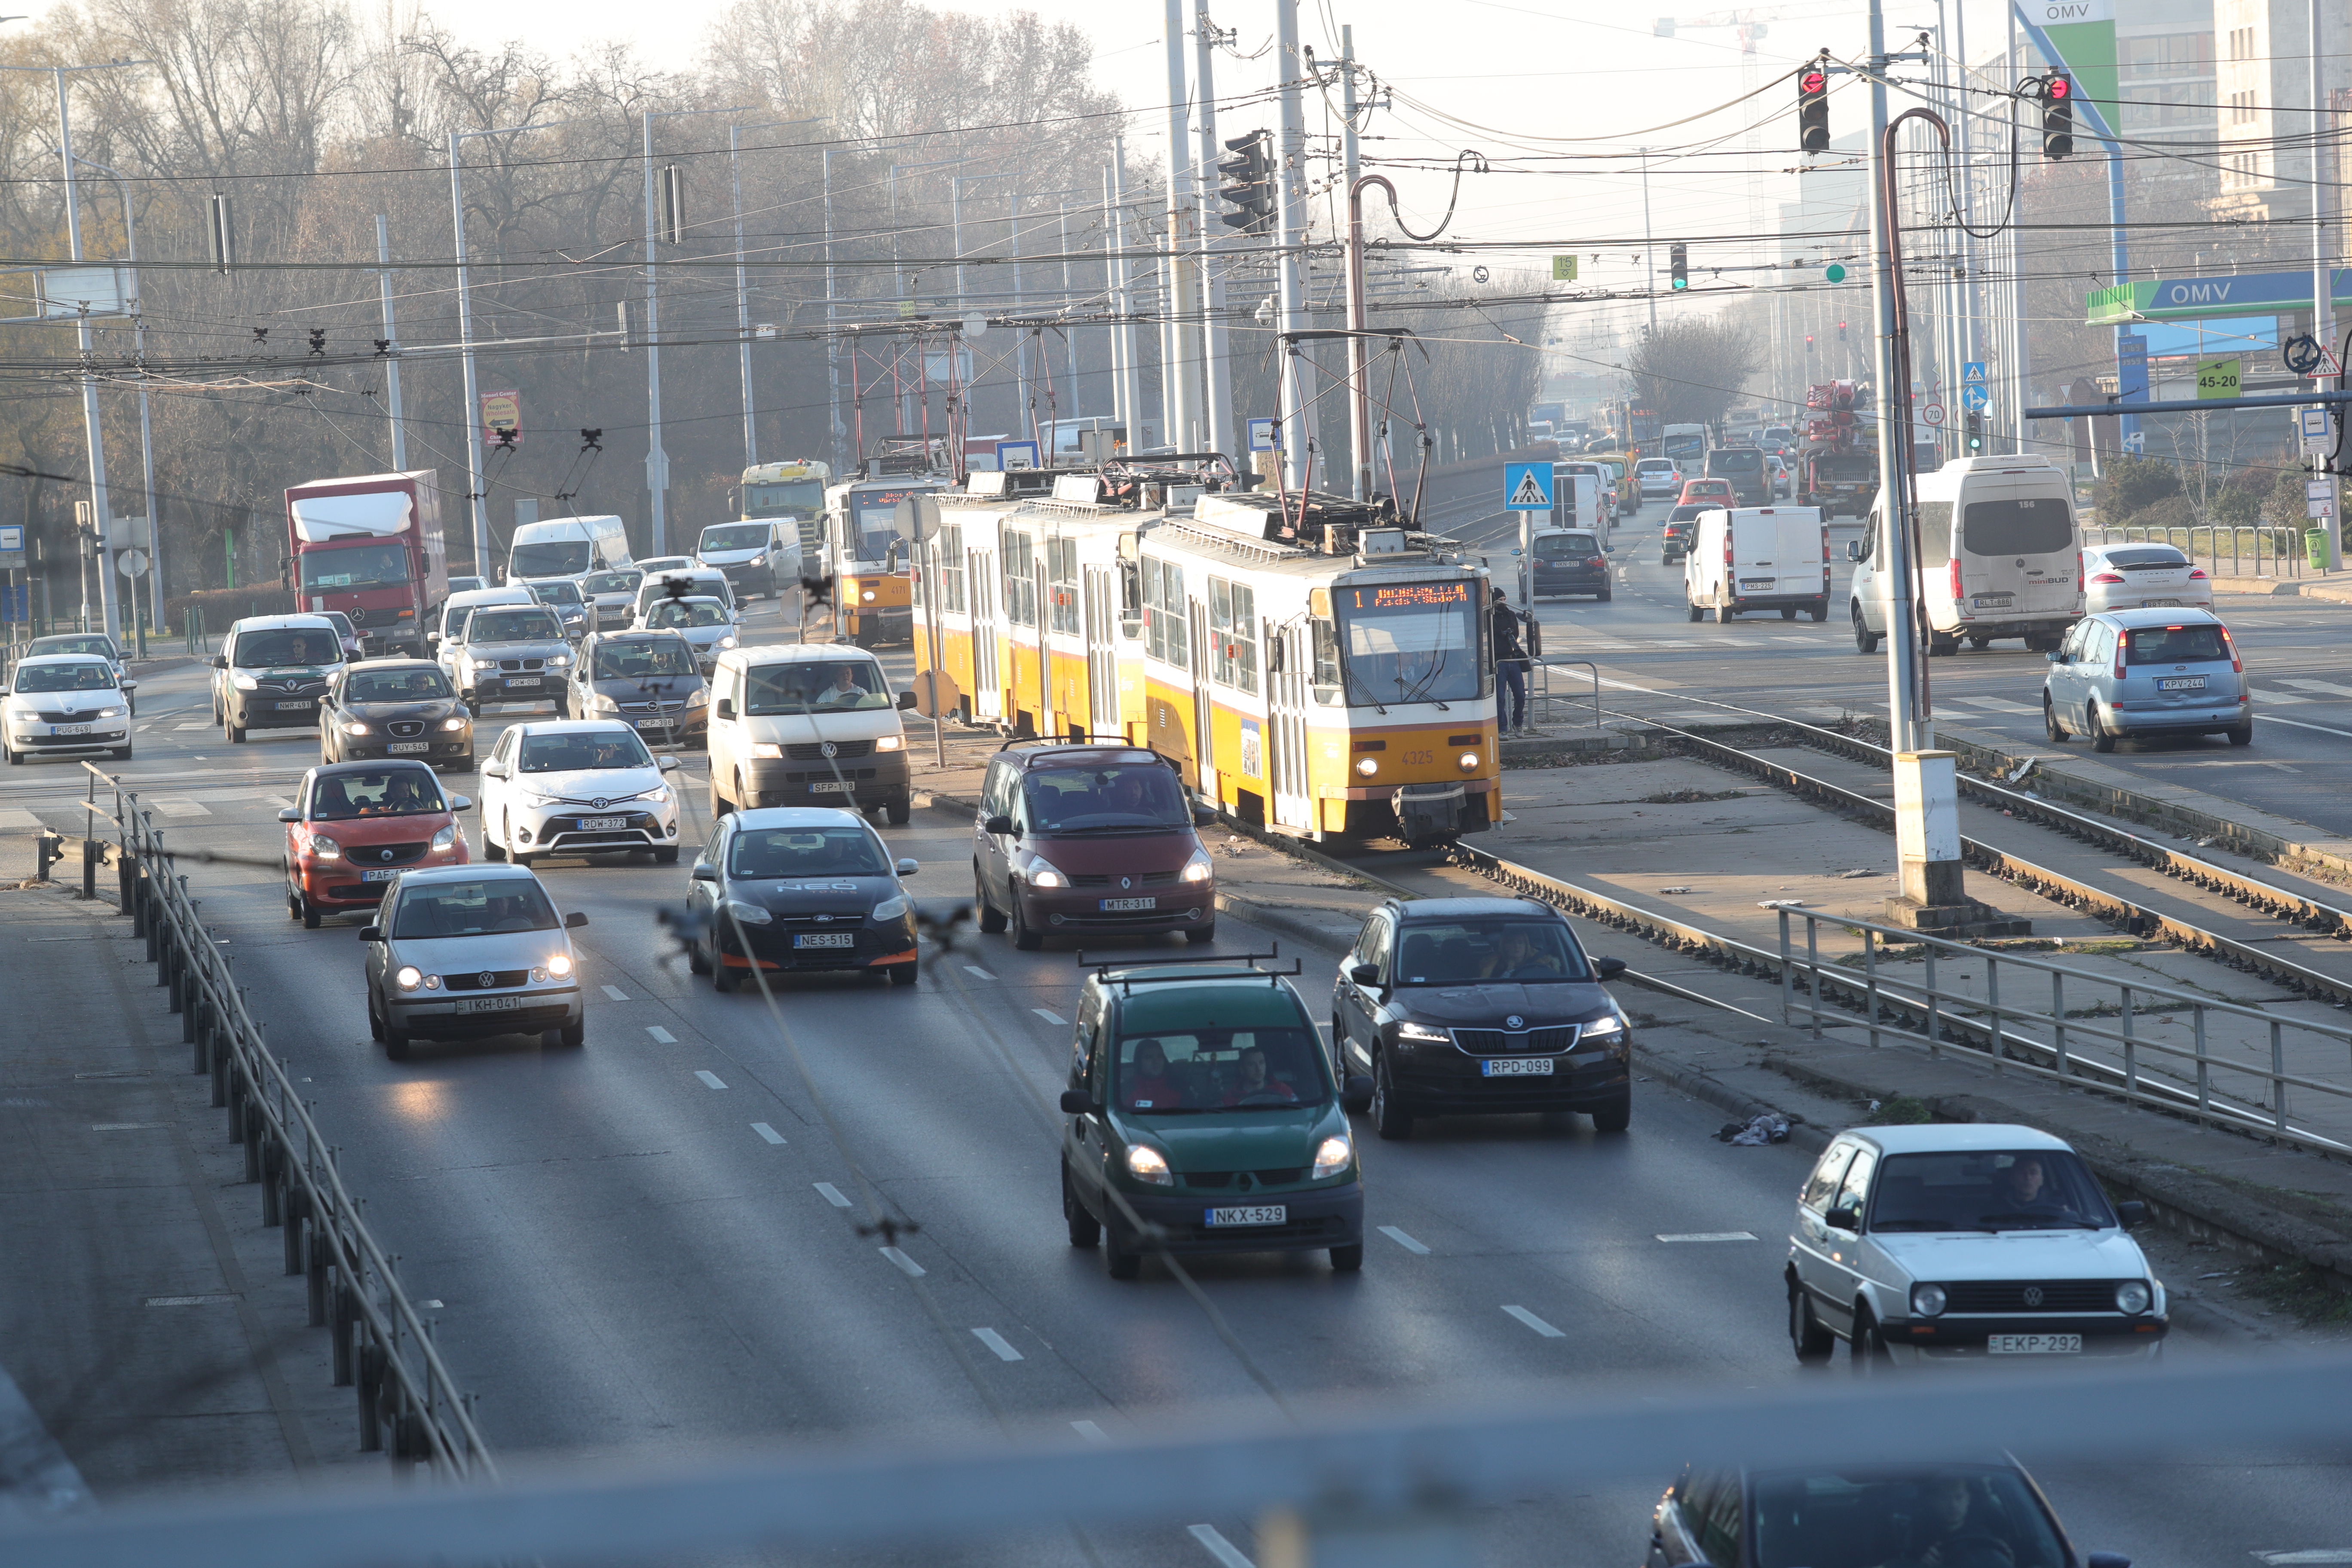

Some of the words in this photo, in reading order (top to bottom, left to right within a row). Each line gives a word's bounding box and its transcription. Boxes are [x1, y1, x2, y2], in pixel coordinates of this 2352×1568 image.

[2047, 3, 2089, 19] OMV
[2171, 282, 2231, 304] OMV
[2199, 376, 2237, 387] 45-20
[1929, 410, 1940, 419] 70
[891, 586, 905, 594] 4171
[1356, 591, 1363, 607] 1
[2165, 680, 2203, 689] KPV-244
[1402, 750, 1433, 766] 4325
[815, 783, 853, 792] SFP-128
[584, 819, 624, 828] RDW-372
[777, 883, 857, 892] NEO
[1107, 898, 1152, 910] MTR-311
[802, 935, 850, 945] NES-515
[469, 998, 517, 1011] IKH-041
[1492, 1060, 1550, 1073] RPD-099
[1216, 1207, 1283, 1223] NKX-529
[2003, 1336, 2080, 1351] EKP-292
